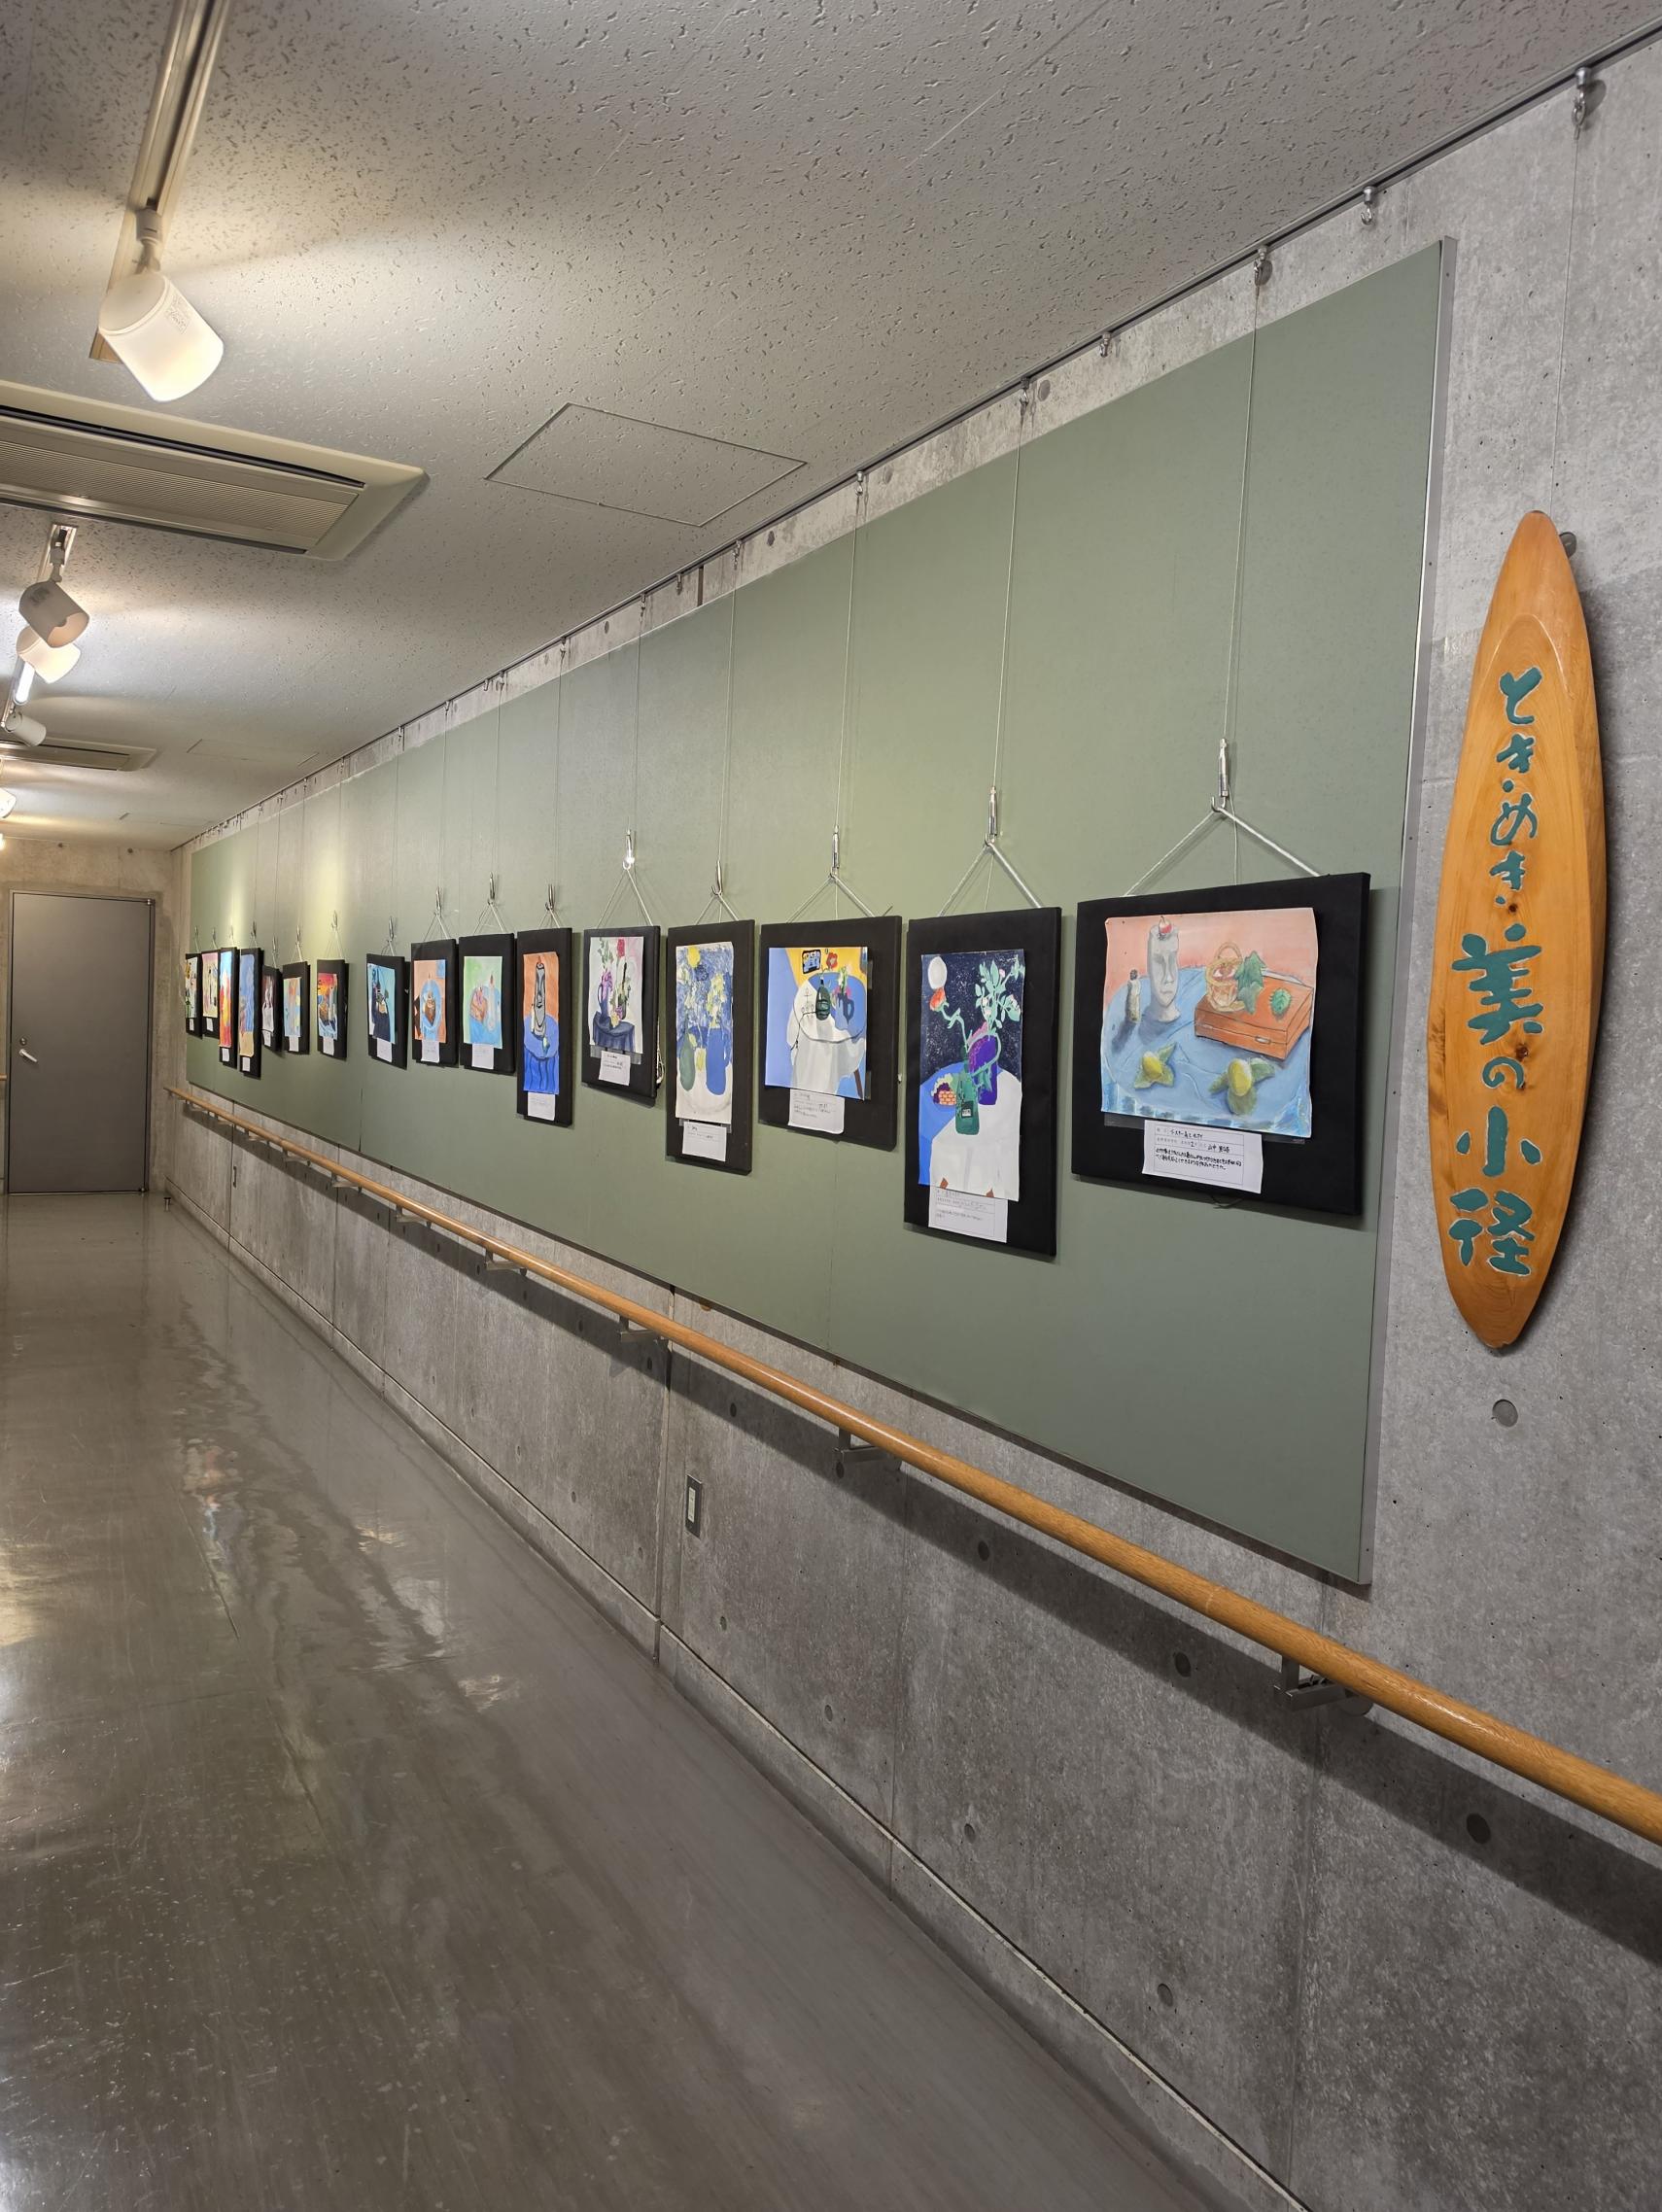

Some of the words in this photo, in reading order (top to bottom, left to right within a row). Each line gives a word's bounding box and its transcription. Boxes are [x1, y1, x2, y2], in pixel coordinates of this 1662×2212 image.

[1451, 667, 1543, 1278] ときめき美の小径
